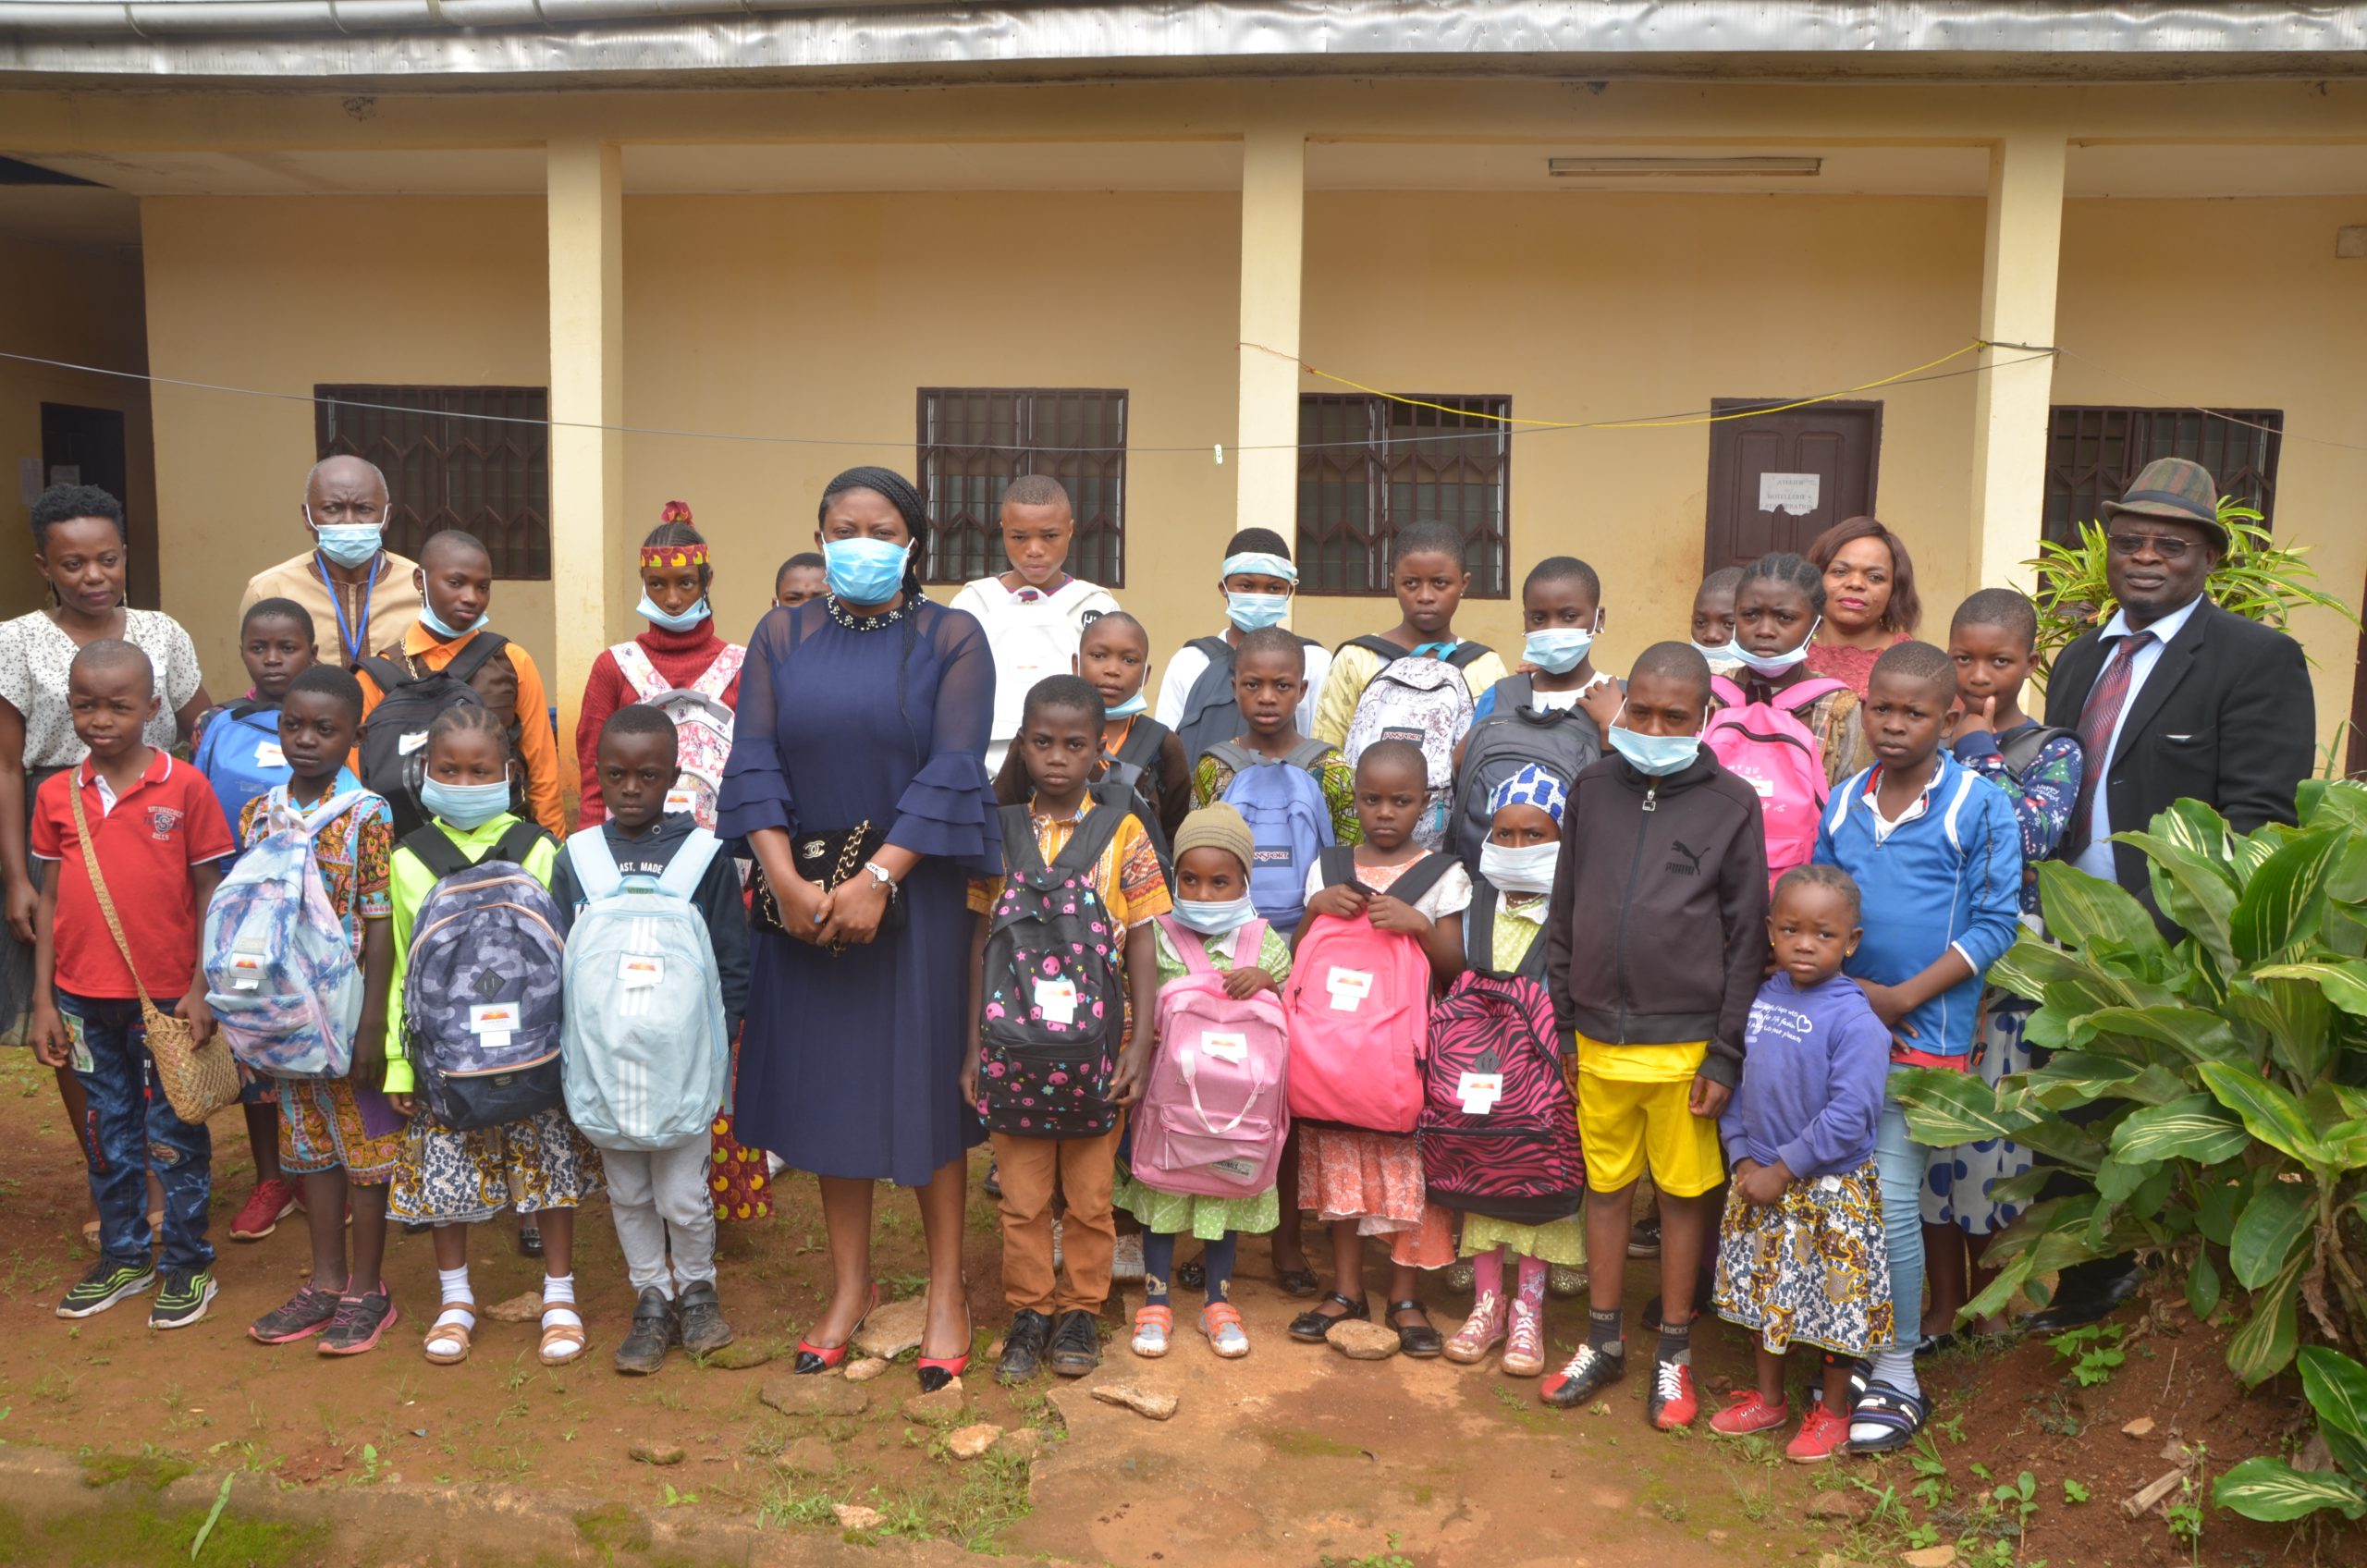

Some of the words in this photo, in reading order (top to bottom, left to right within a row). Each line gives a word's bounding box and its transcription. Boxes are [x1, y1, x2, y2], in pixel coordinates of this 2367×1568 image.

[1253, 851, 1290, 862] ANSPORT
[640, 862, 664, 875] MADE
[1665, 862, 1695, 876] PUMA
